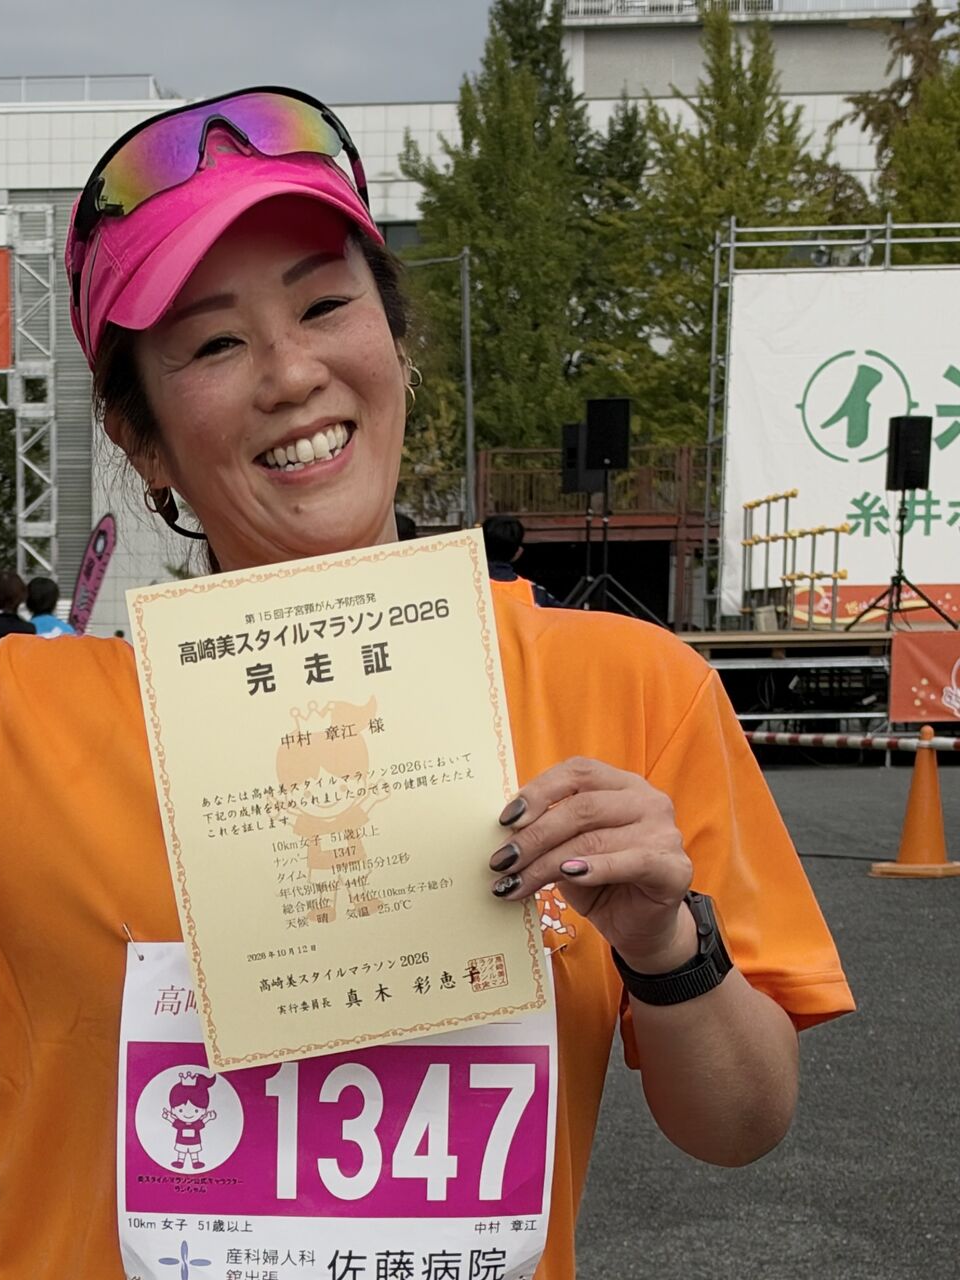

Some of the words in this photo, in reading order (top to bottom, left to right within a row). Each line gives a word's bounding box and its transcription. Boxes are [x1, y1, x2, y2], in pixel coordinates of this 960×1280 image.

[281, 730, 312, 750] 中村
[369, 717, 385, 735] 様
[207, 816, 289, 838] これを証します
[330, 825, 380, 844] 51歳以上
[273, 853, 308, 868] ナンバー
[333, 845, 357, 859] 1347
[277, 870, 307, 883] タイム
[282, 897, 331, 916] 総合順位
[286, 916, 310, 930] 天候
[345, 906, 370, 920] 気温
[265, 1062, 536, 1201] 1347
[128, 1218, 156, 1230] 10km
[161, 1218, 188, 1231] 女子
[198, 1220, 253, 1233] 51歳以上
[474, 1221, 500, 1234] 中村
[510, 1219, 537, 1232] 章江
[225, 1248, 316, 1267] 産科婦人科
